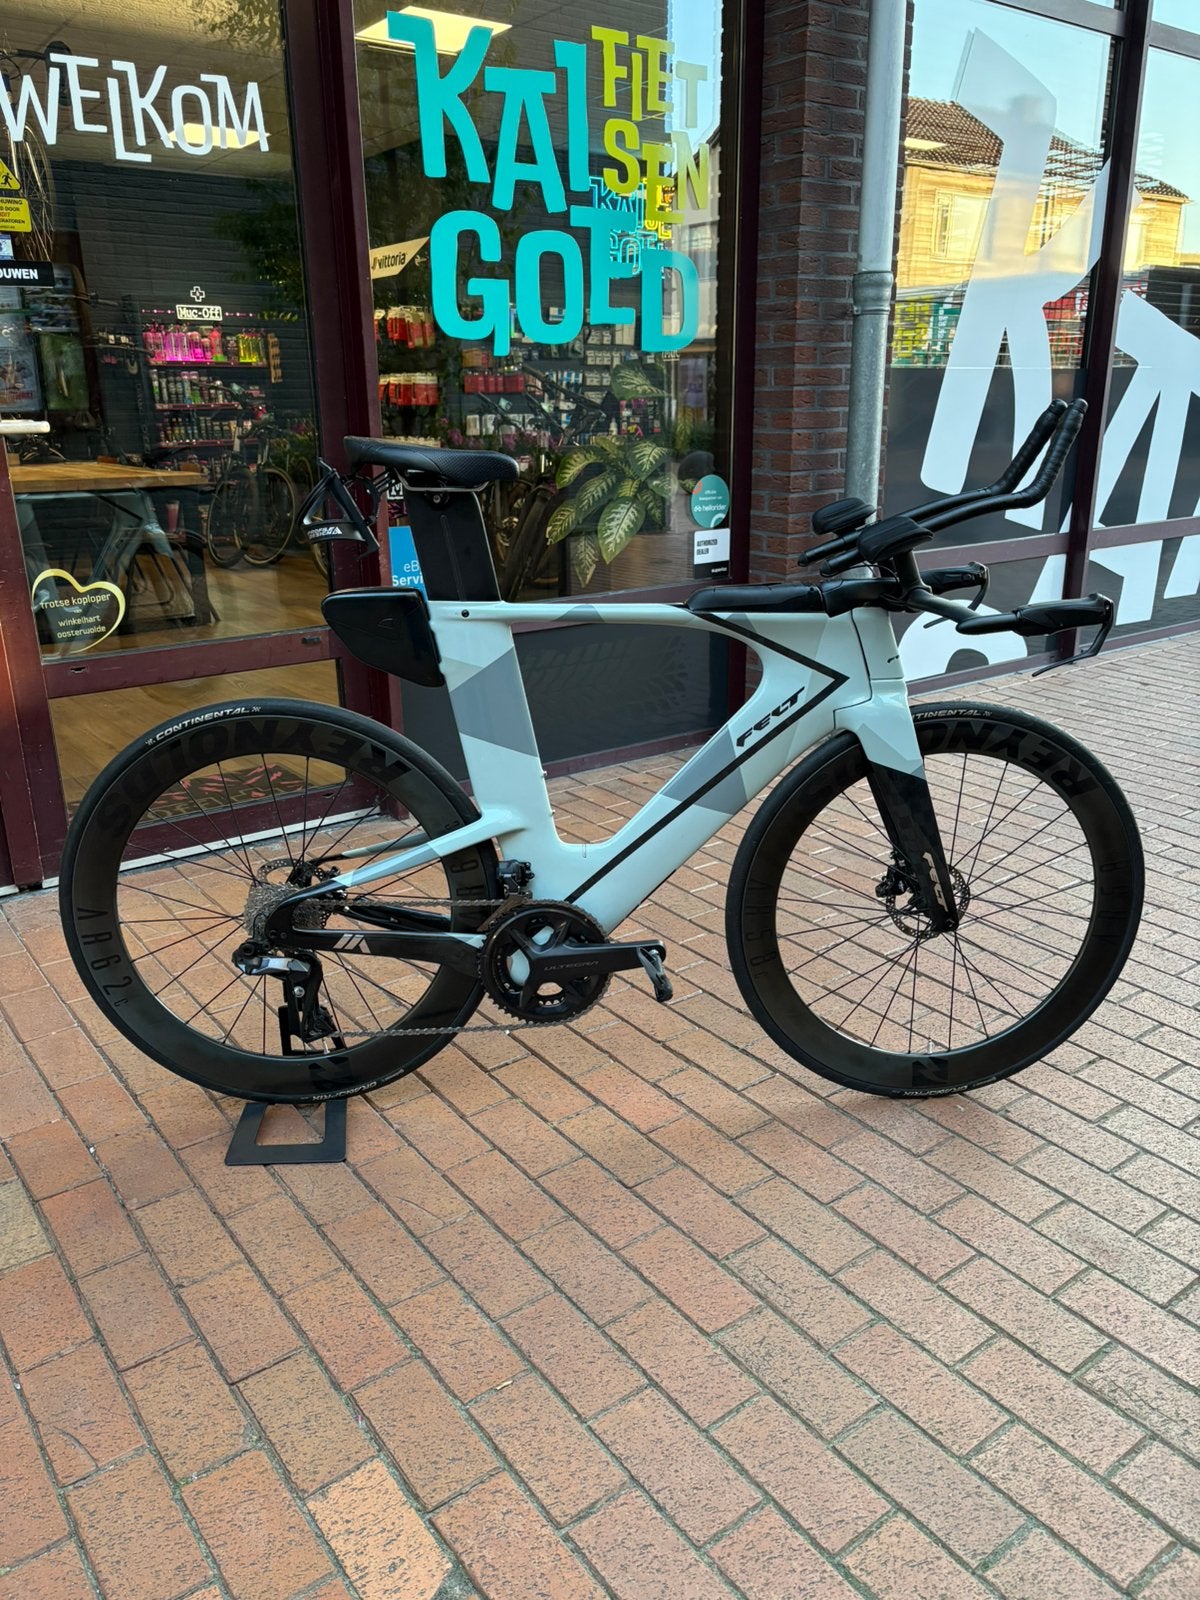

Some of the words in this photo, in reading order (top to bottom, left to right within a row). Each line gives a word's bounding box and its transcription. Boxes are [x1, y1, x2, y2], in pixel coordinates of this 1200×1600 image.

[0, 53, 269, 163] WELKOM
[387, 11, 589, 213] KAI
[377, 252, 406, 270] vittoria
[430, 205, 699, 356] GOED
[179, 307, 220, 319] Muc-Off
[392, 573, 424, 588] Servi
[72, 593, 111, 606] koploper
[58, 615, 101, 628] winkelhart
[736, 686, 805, 747] FELT
[912, 708, 982, 721] TINENTAL
[155, 706, 250, 741] CONTINENTAL
[543, 960, 600, 971] ULTEGRA
